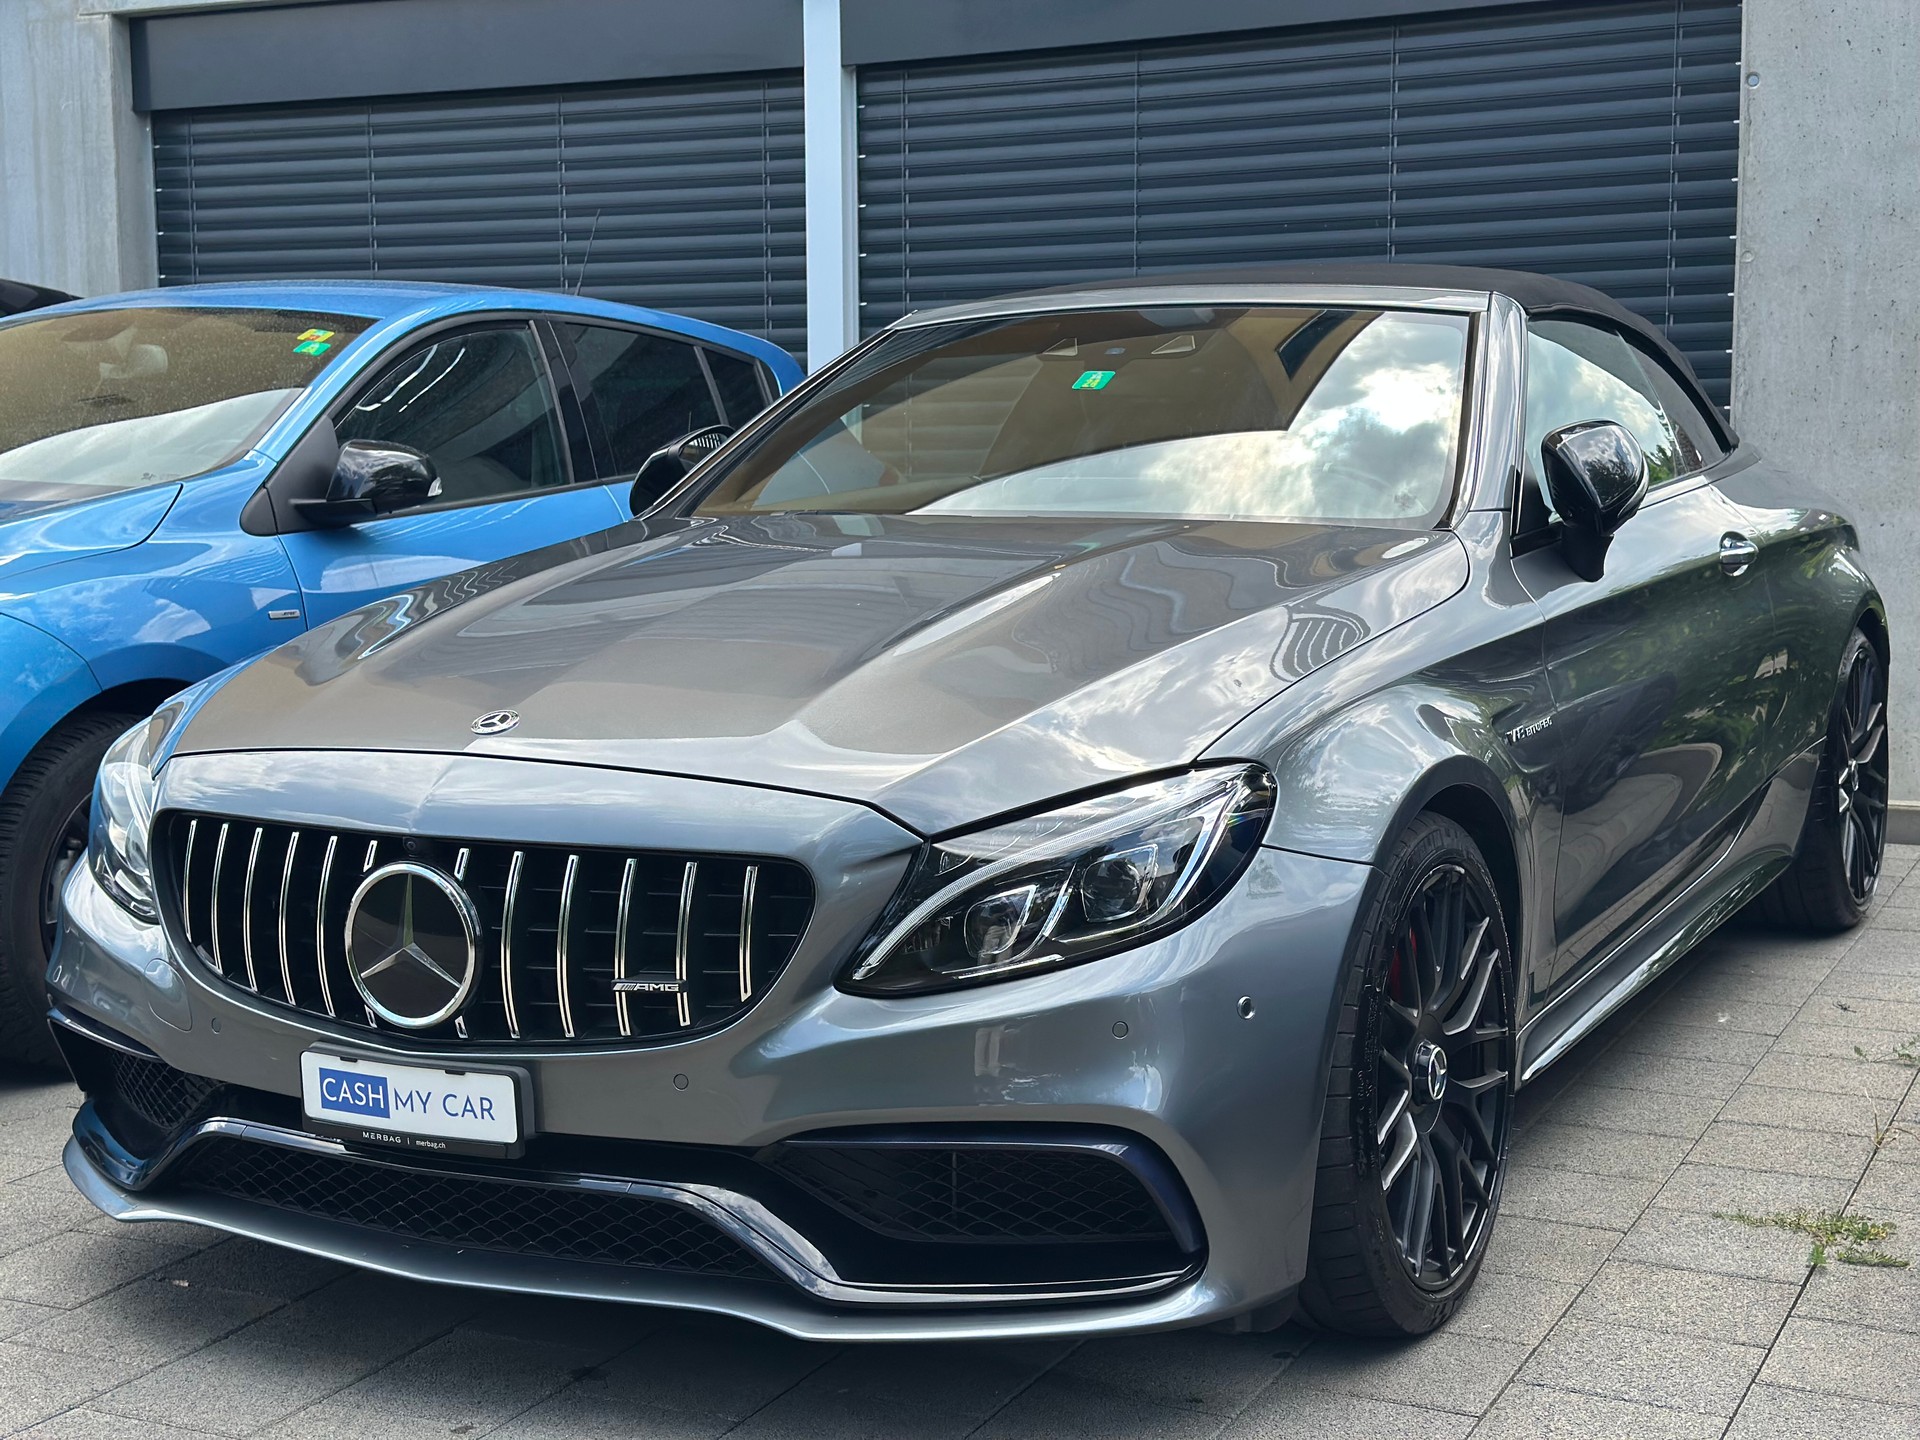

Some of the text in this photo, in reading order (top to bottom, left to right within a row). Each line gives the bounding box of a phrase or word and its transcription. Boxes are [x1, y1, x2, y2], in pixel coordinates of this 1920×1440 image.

[633, 983, 679, 992] AMG
[322, 1077, 496, 1121] CASH MY CAR
[362, 1131, 446, 1149] MERBAG merbag.ch
